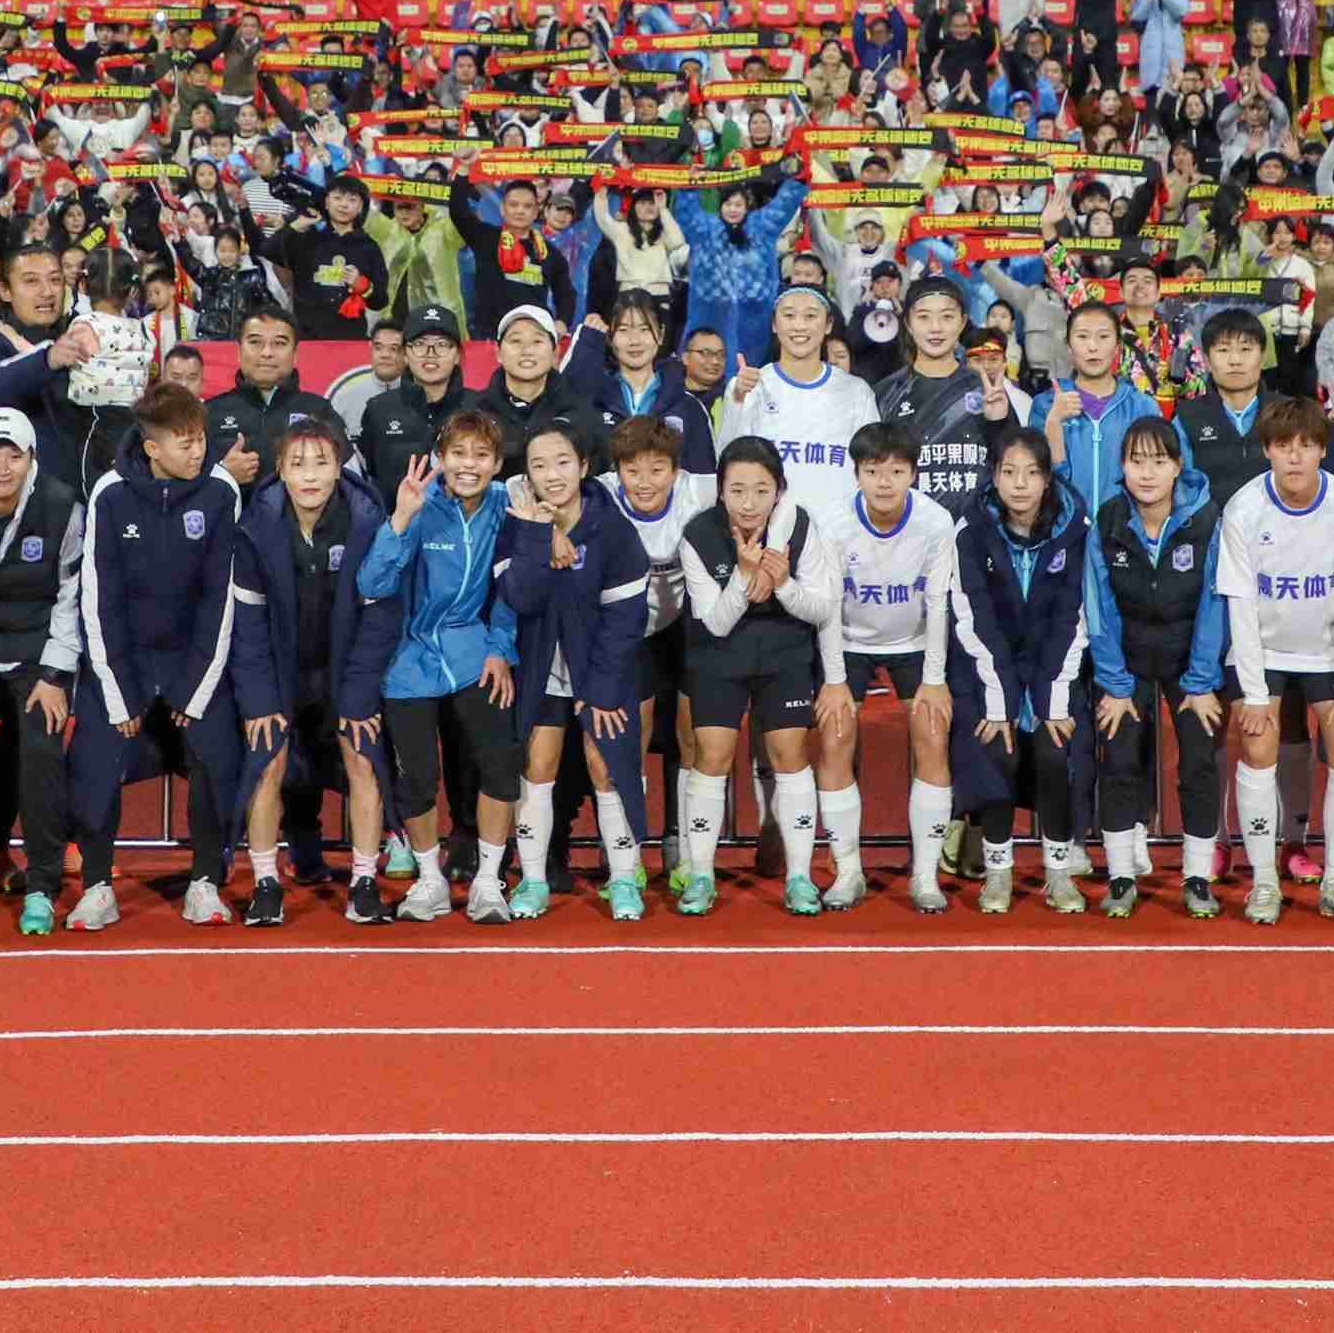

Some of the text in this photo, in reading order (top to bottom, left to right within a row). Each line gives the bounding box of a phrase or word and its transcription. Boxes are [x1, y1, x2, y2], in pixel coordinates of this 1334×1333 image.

[777, 440, 848, 468] 天体育
[423, 543, 456, 551] KELME
[784, 698, 811, 708] KEL
